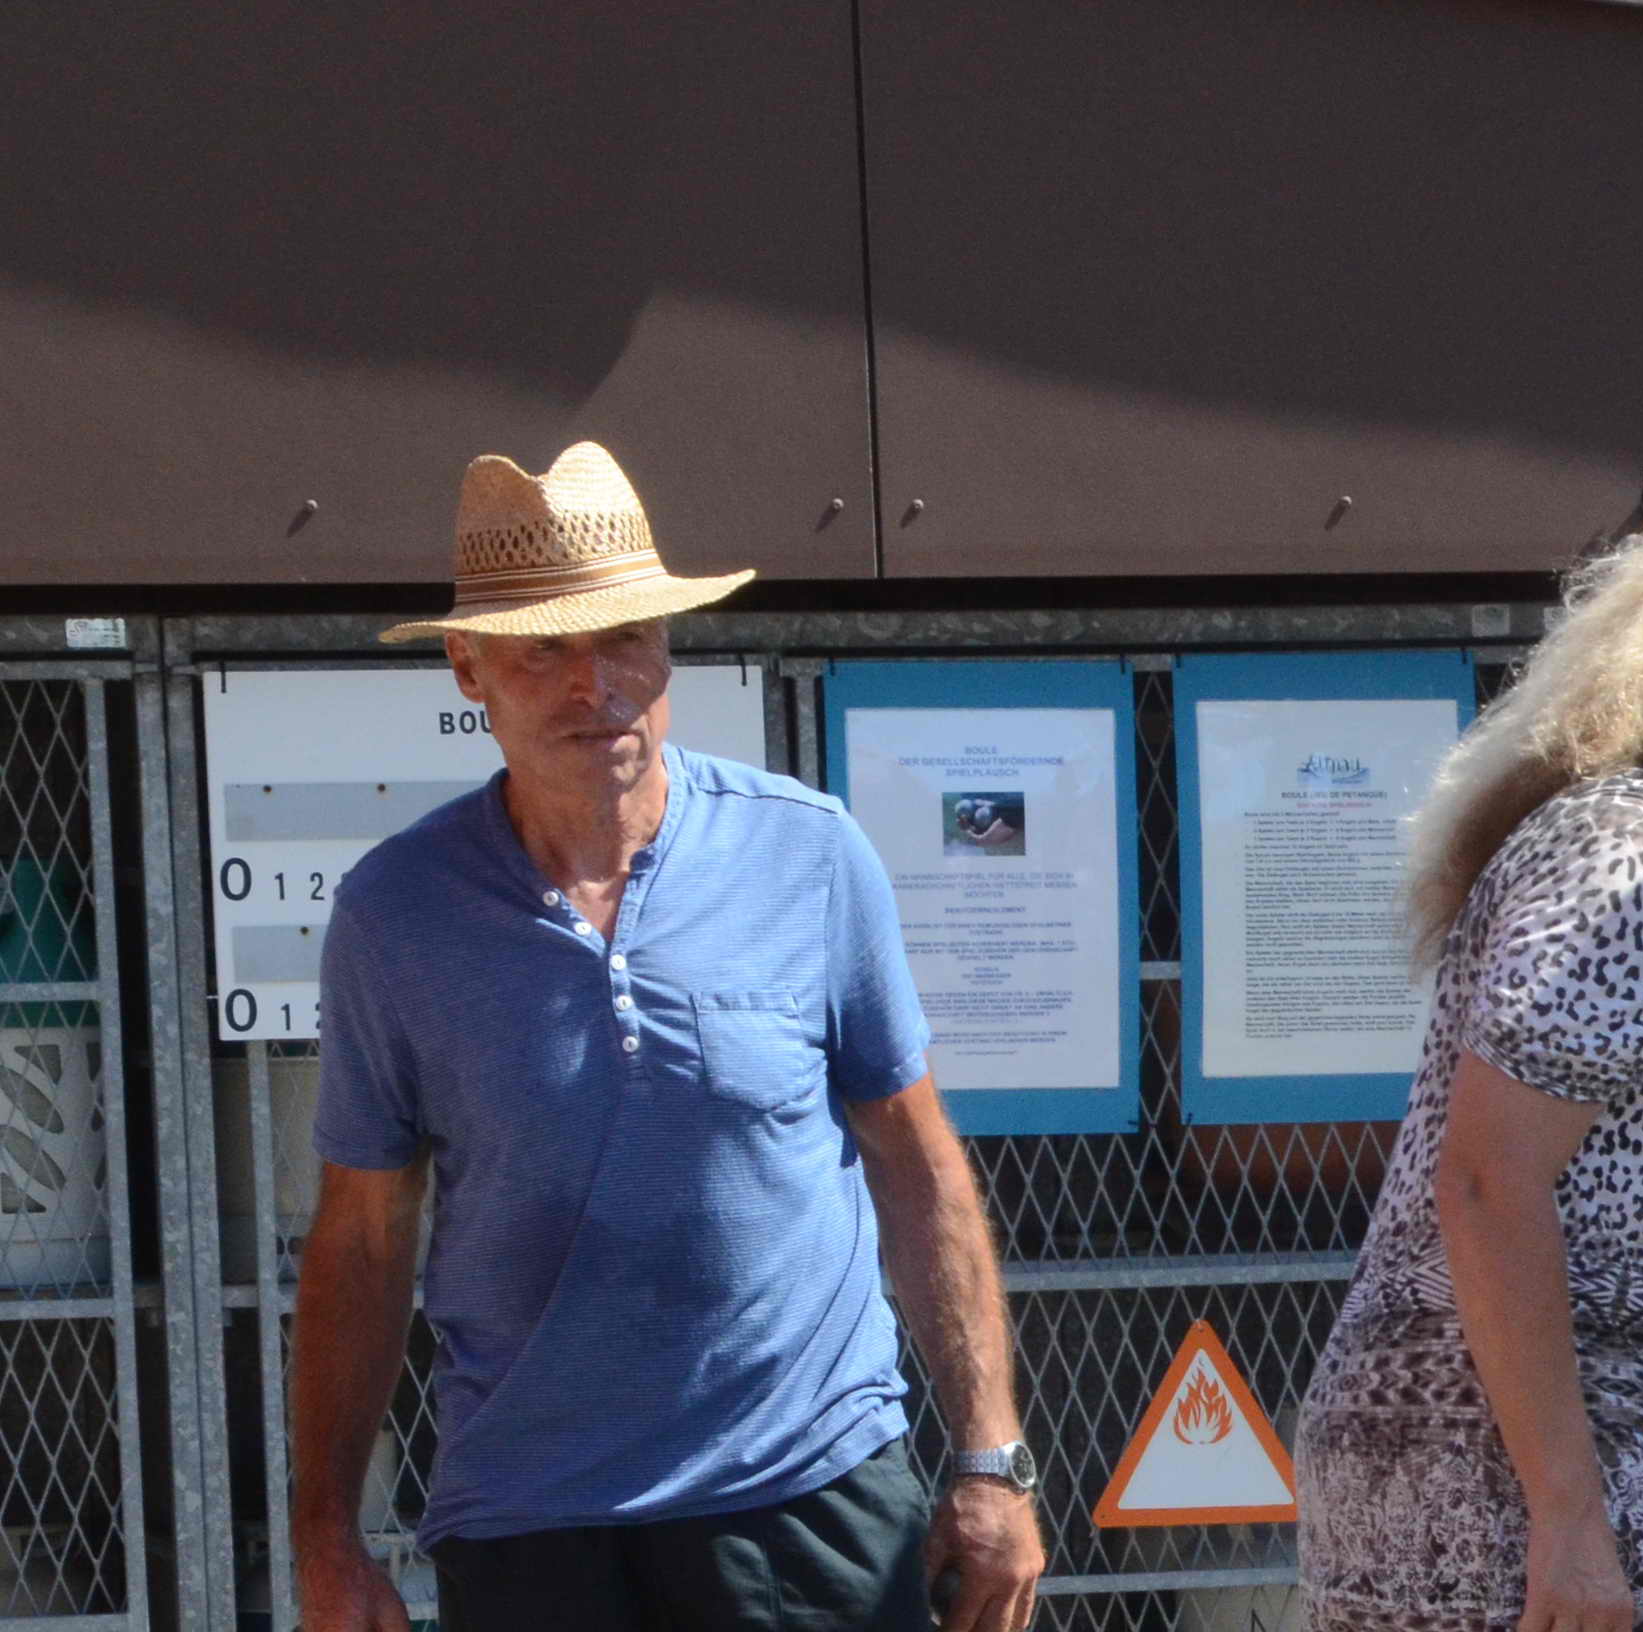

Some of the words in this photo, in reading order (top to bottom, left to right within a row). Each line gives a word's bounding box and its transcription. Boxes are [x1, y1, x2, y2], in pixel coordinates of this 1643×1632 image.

[220, 857, 252, 901] 0
[274, 872, 285, 900] 1
[310, 872, 325, 901] 2
[225, 988, 258, 1032] 0
[280, 1003, 291, 1031] 1
